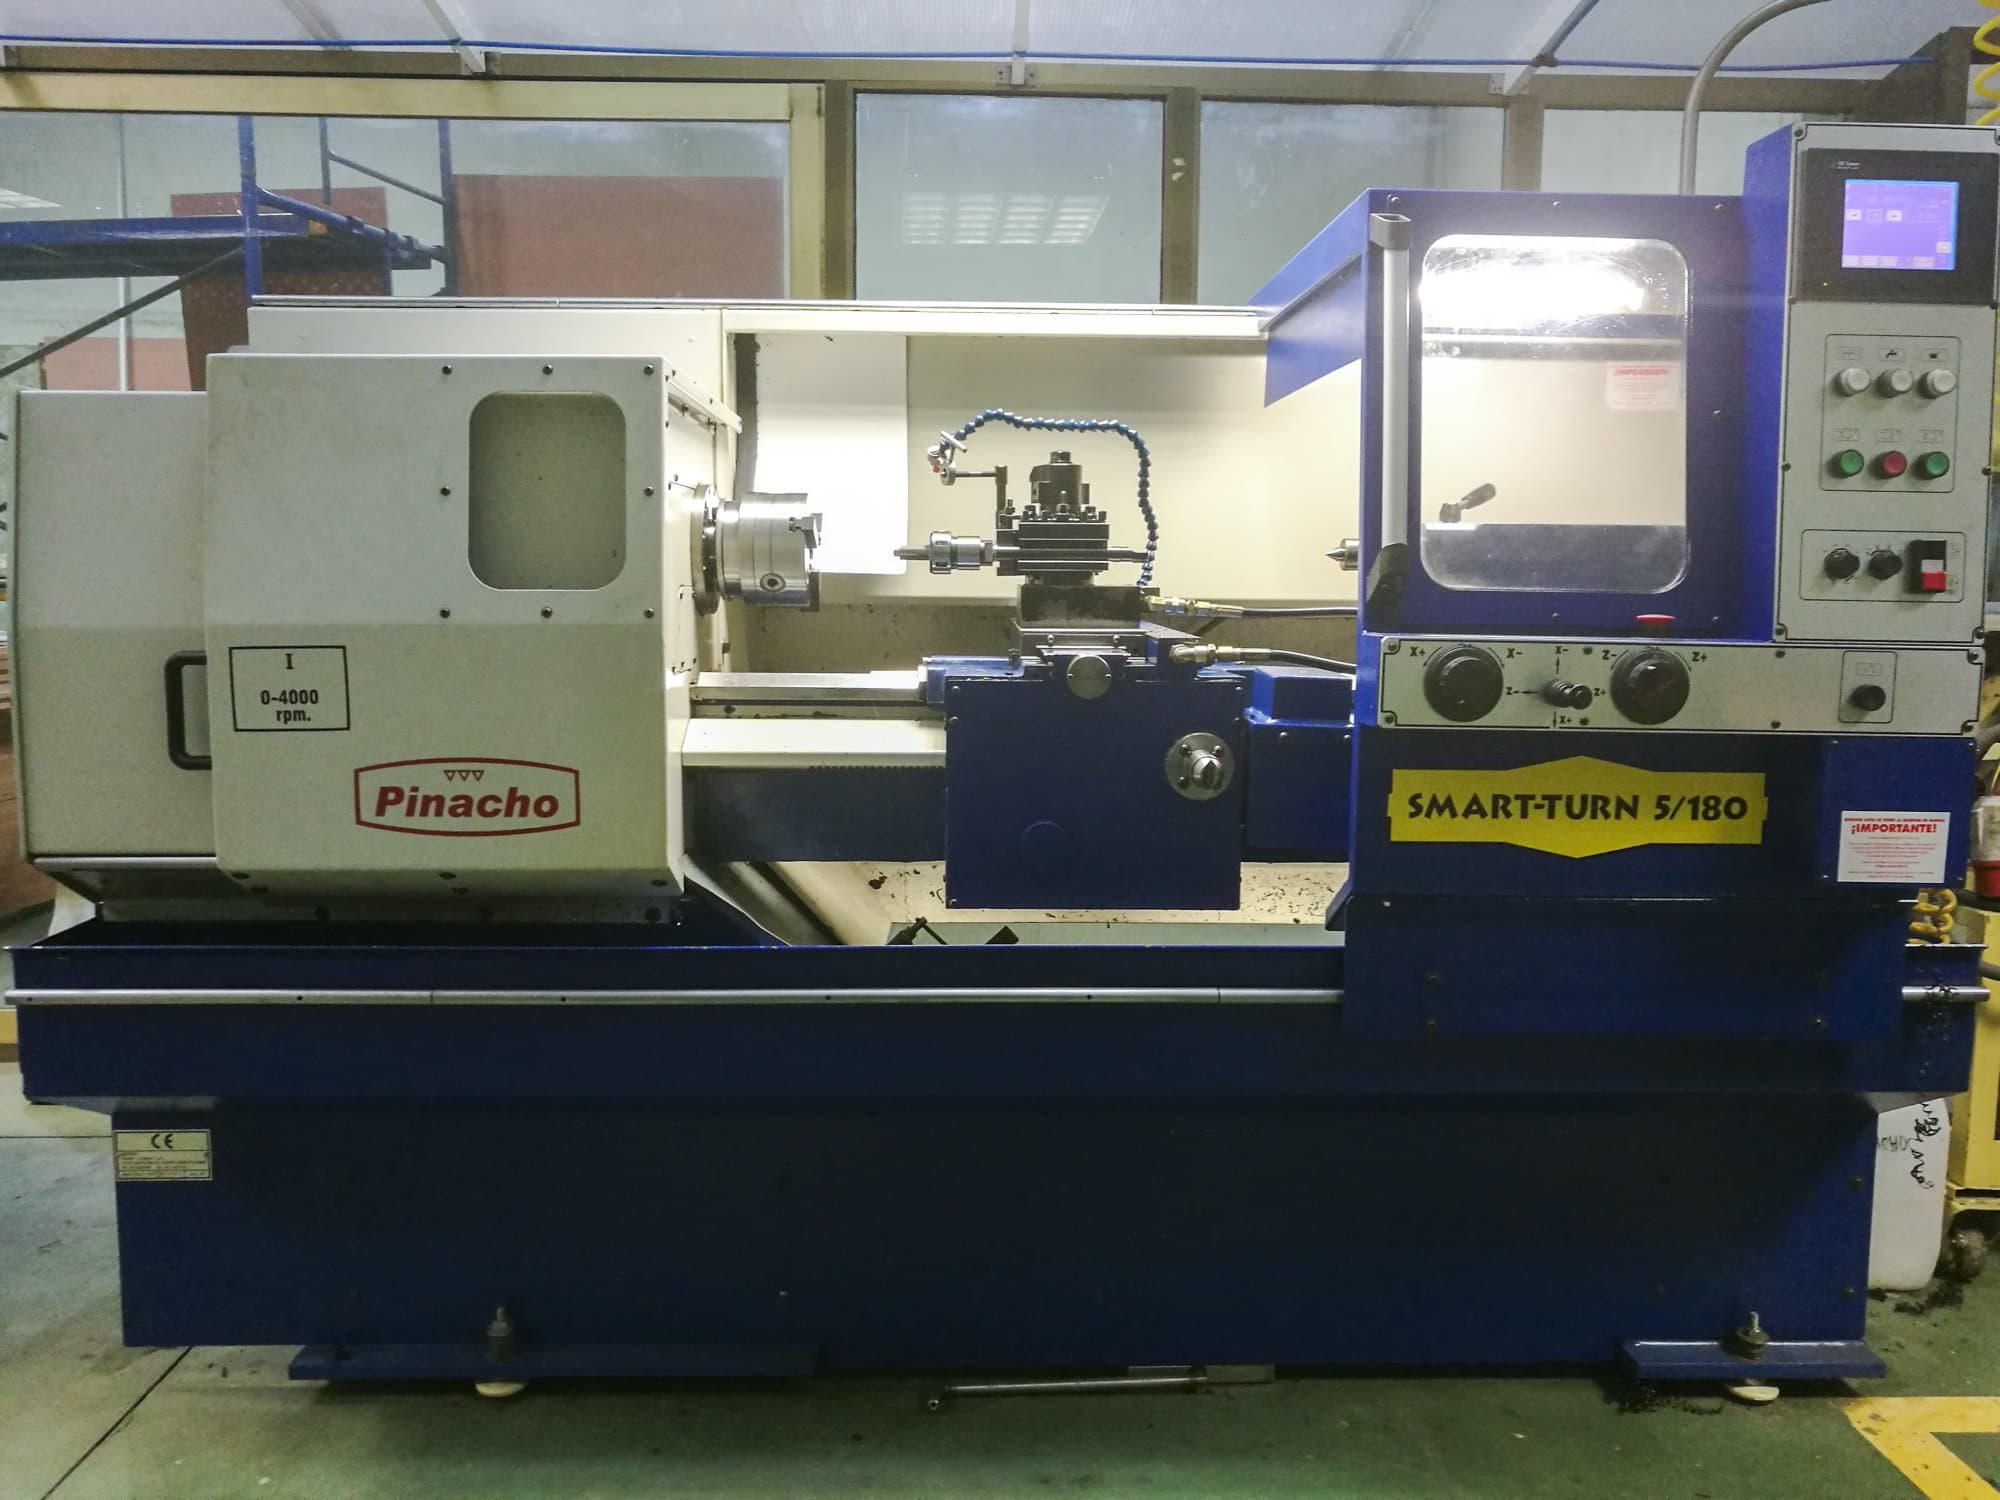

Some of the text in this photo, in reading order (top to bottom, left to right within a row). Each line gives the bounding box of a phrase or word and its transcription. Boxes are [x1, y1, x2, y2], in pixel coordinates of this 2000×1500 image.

[1409, 646, 1426, 657] X+
[1506, 648, 1523, 658] X-
[1602, 650, 1617, 660] Z-
[1692, 651, 1708, 662] Z+
[285, 653, 294, 670] I
[1506, 686, 1520, 696] Z-
[1593, 687, 1607, 697] Z+
[260, 689, 319, 705] 0-4000
[276, 710, 311, 725] rpm.
[1559, 715, 1572, 725] X+
[375, 786, 559, 818] Pinacho
[1408, 793, 1748, 821] SMART-TURN 5/180
